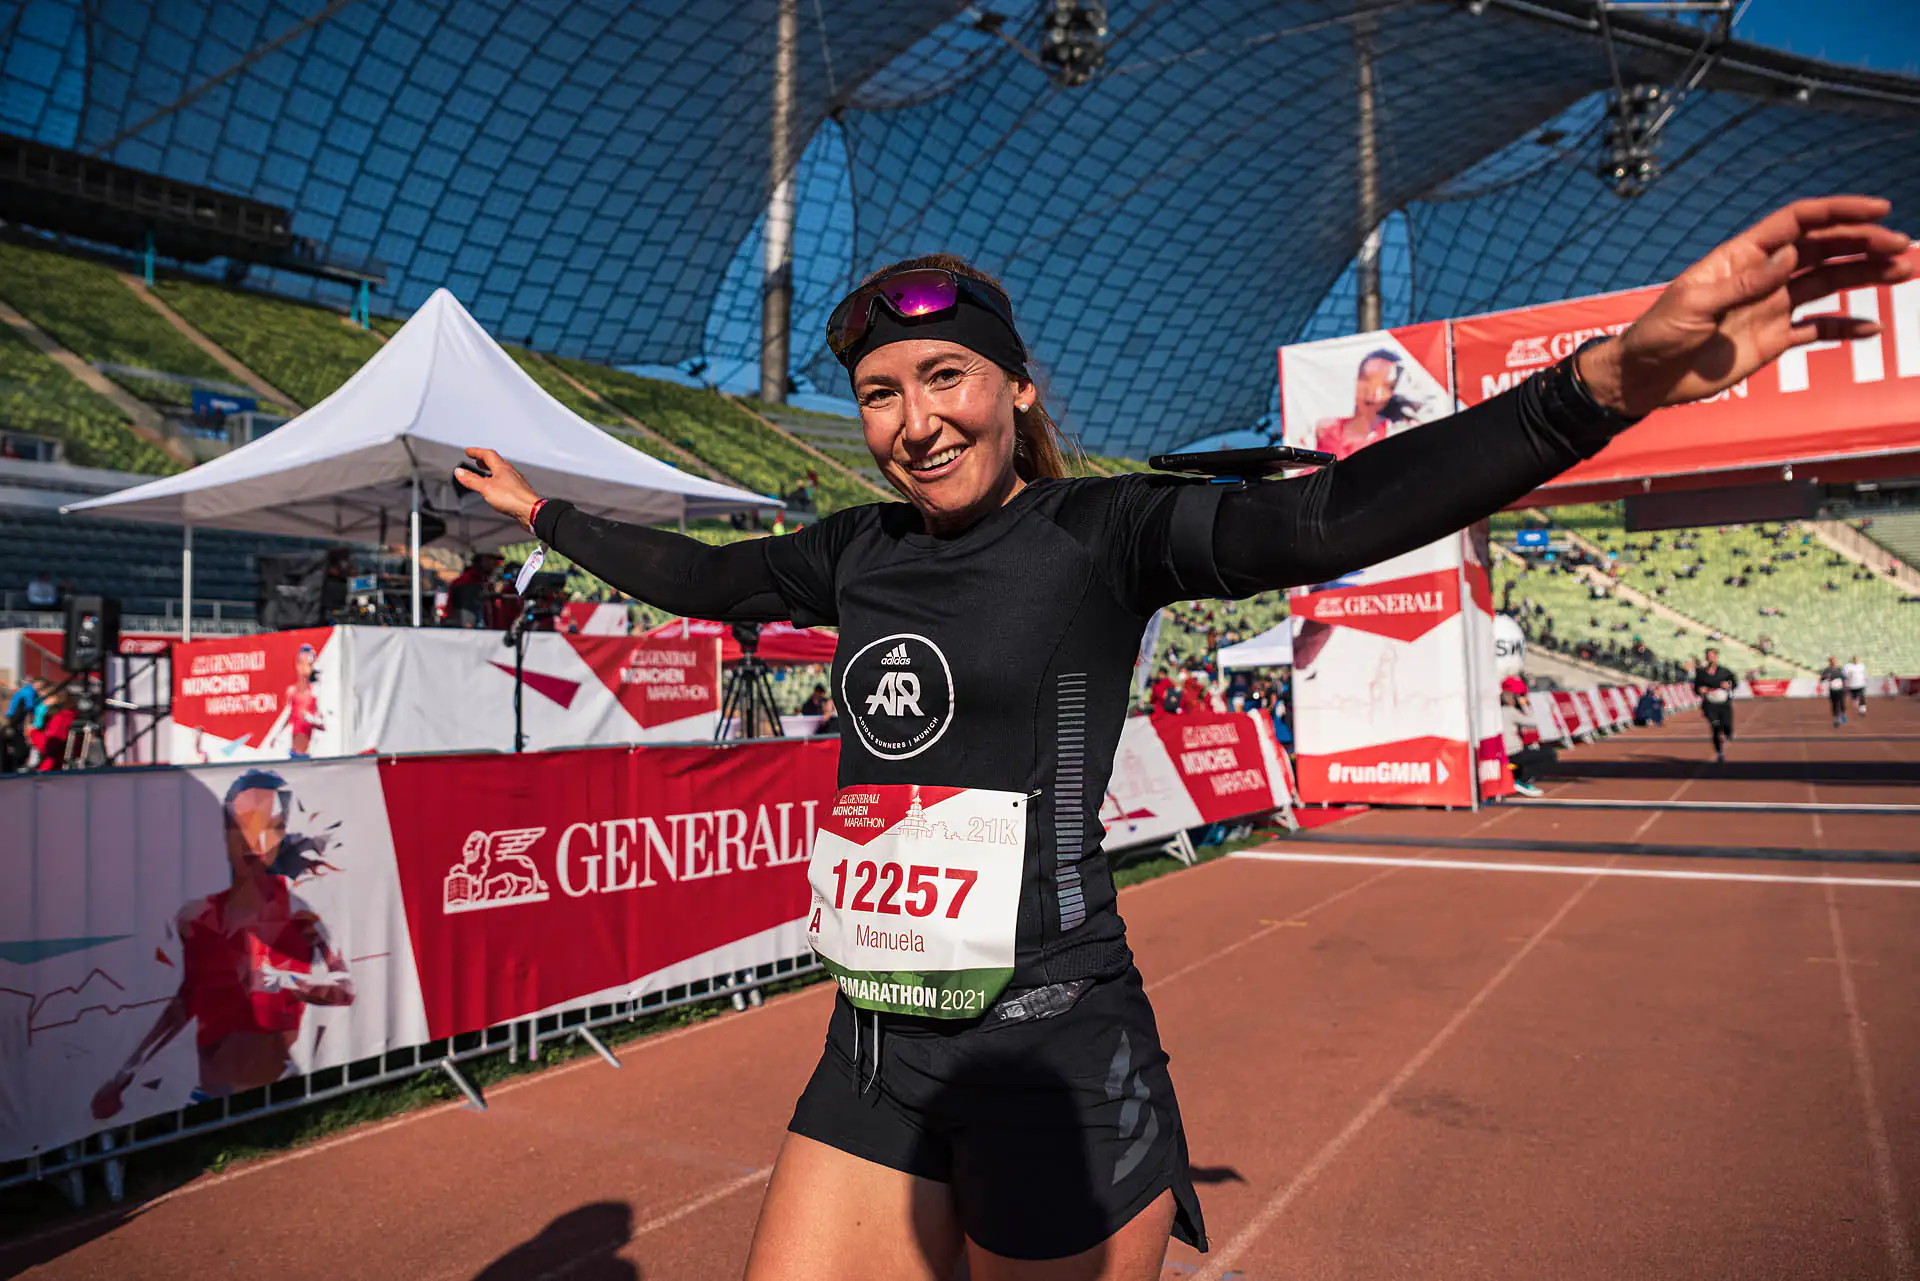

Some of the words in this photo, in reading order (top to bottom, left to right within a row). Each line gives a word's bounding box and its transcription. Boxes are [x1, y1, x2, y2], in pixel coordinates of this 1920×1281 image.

[1777, 278, 1920, 393] FI
[1344, 591, 1443, 614] GENERALI
[881, 656, 911, 666] adidas
[875, 737, 906, 749] RUNNERS
[913, 716, 939, 744] MUNICH
[1328, 762, 1431, 784] #runGMM
[847, 793, 880, 804] GENERALI
[844, 817, 885, 828] MARATHON
[967, 816, 1019, 846] 21K
[555, 800, 818, 898] GENERALI
[832, 858, 979, 919] 12257
[809, 907, 821, 933] A
[856, 924, 925, 953] Manuela
[940, 989, 985, 1010] 2021
